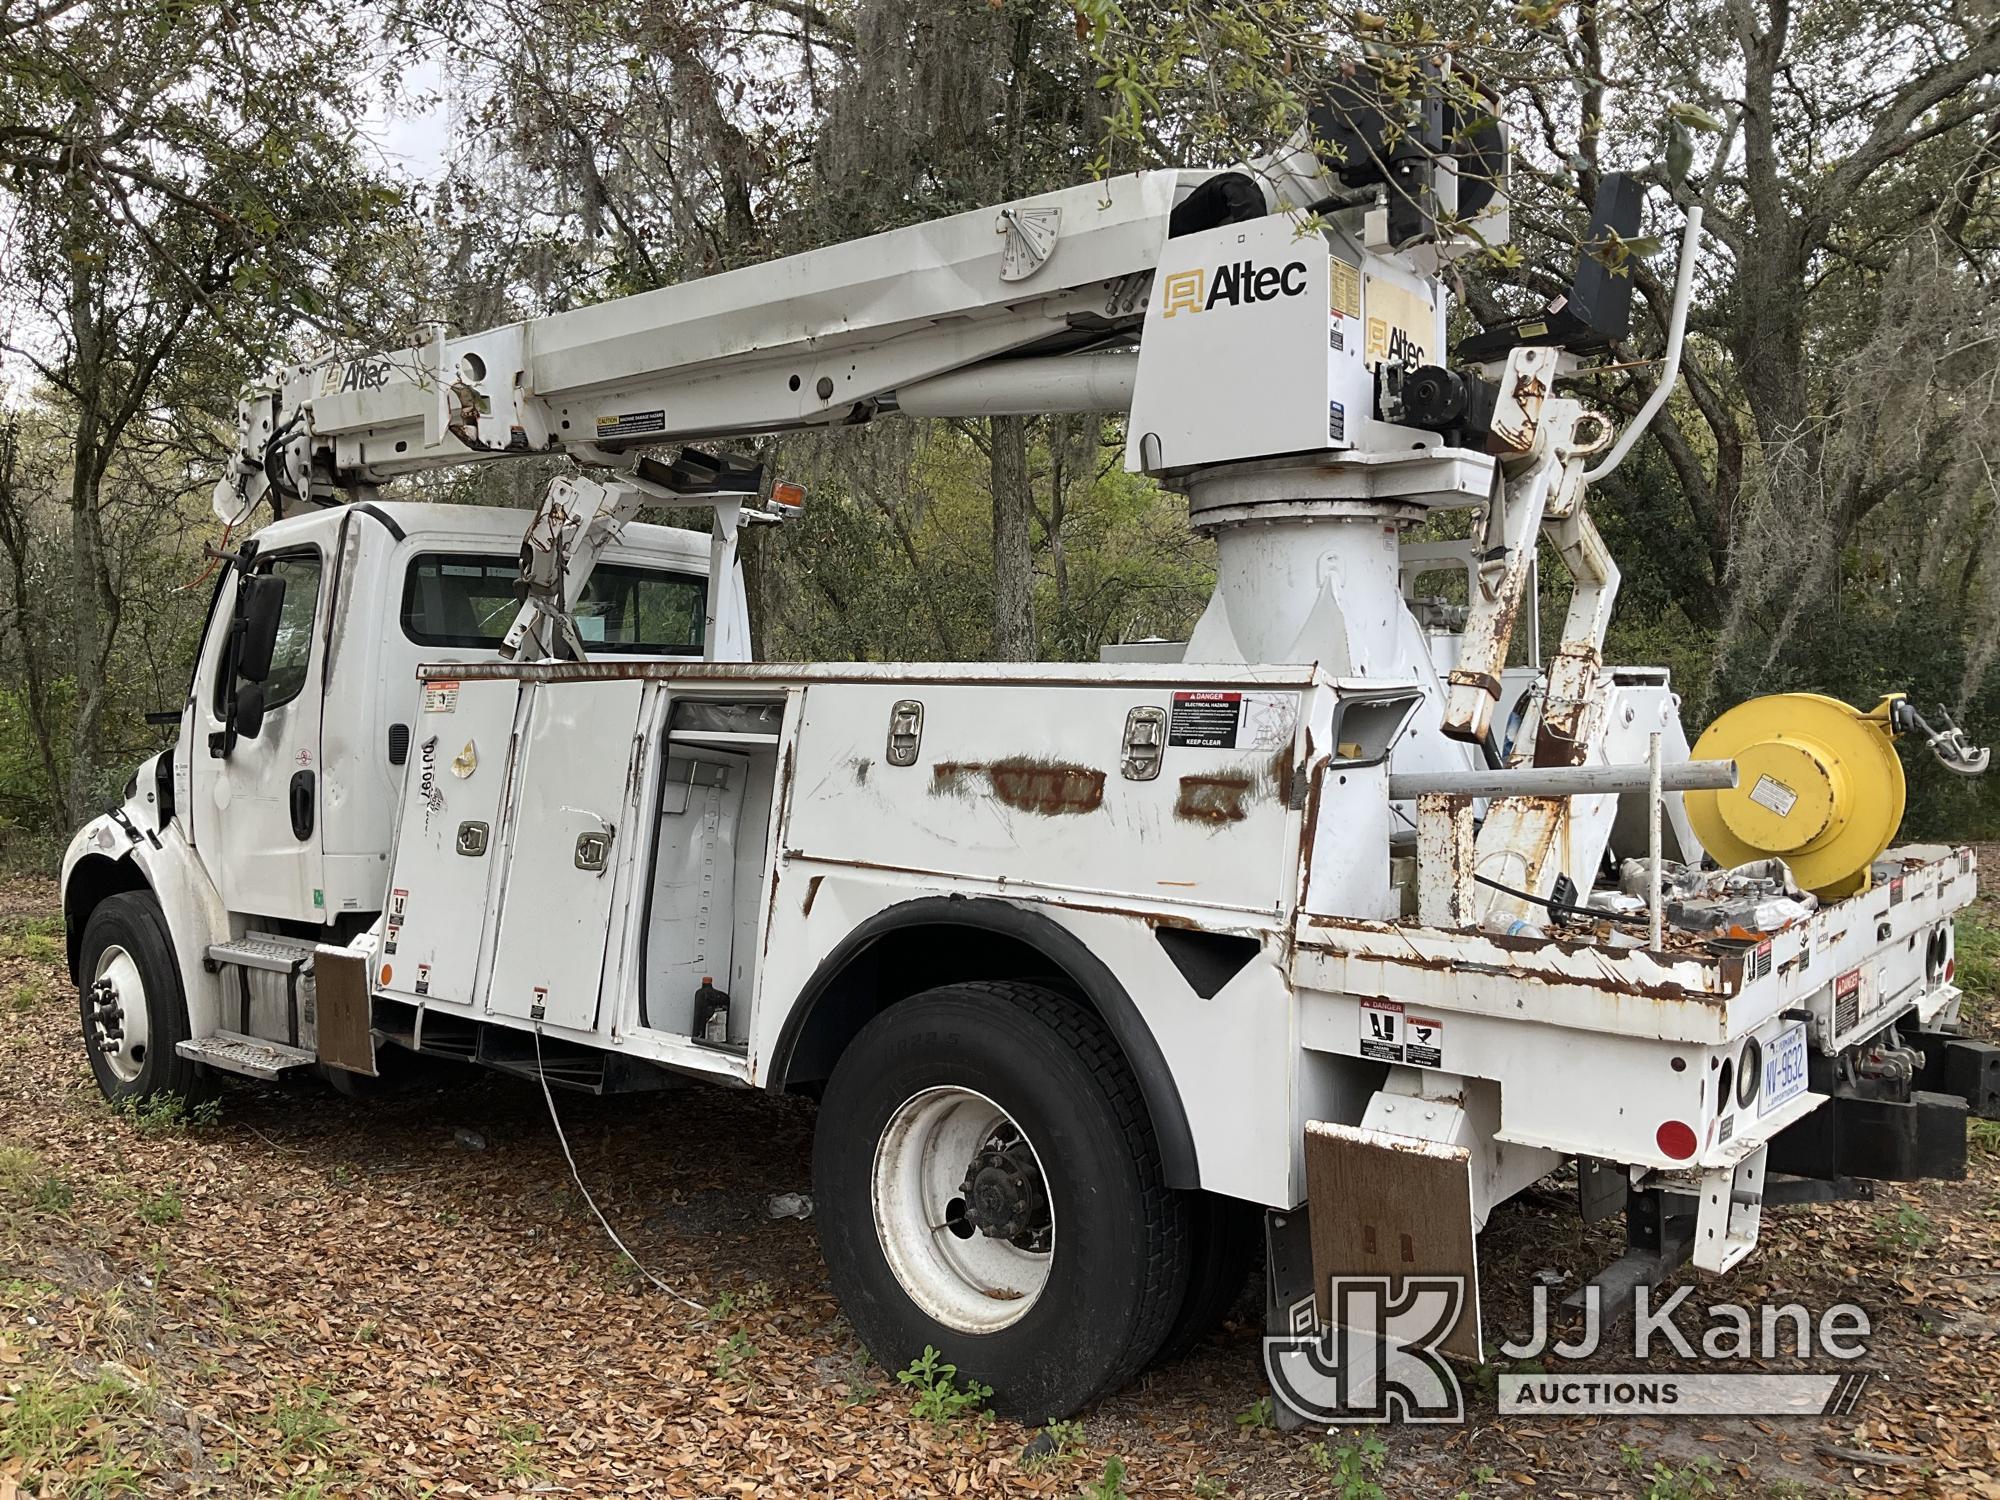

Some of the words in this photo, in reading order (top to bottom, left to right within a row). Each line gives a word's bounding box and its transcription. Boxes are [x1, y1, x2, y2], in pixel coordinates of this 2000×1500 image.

[1205, 260, 1306, 310] Altec
[1388, 327, 1424, 369] Altec
[1373, 1002, 1402, 1012] DANGER
[1766, 1043, 1803, 1097] NV-9632
